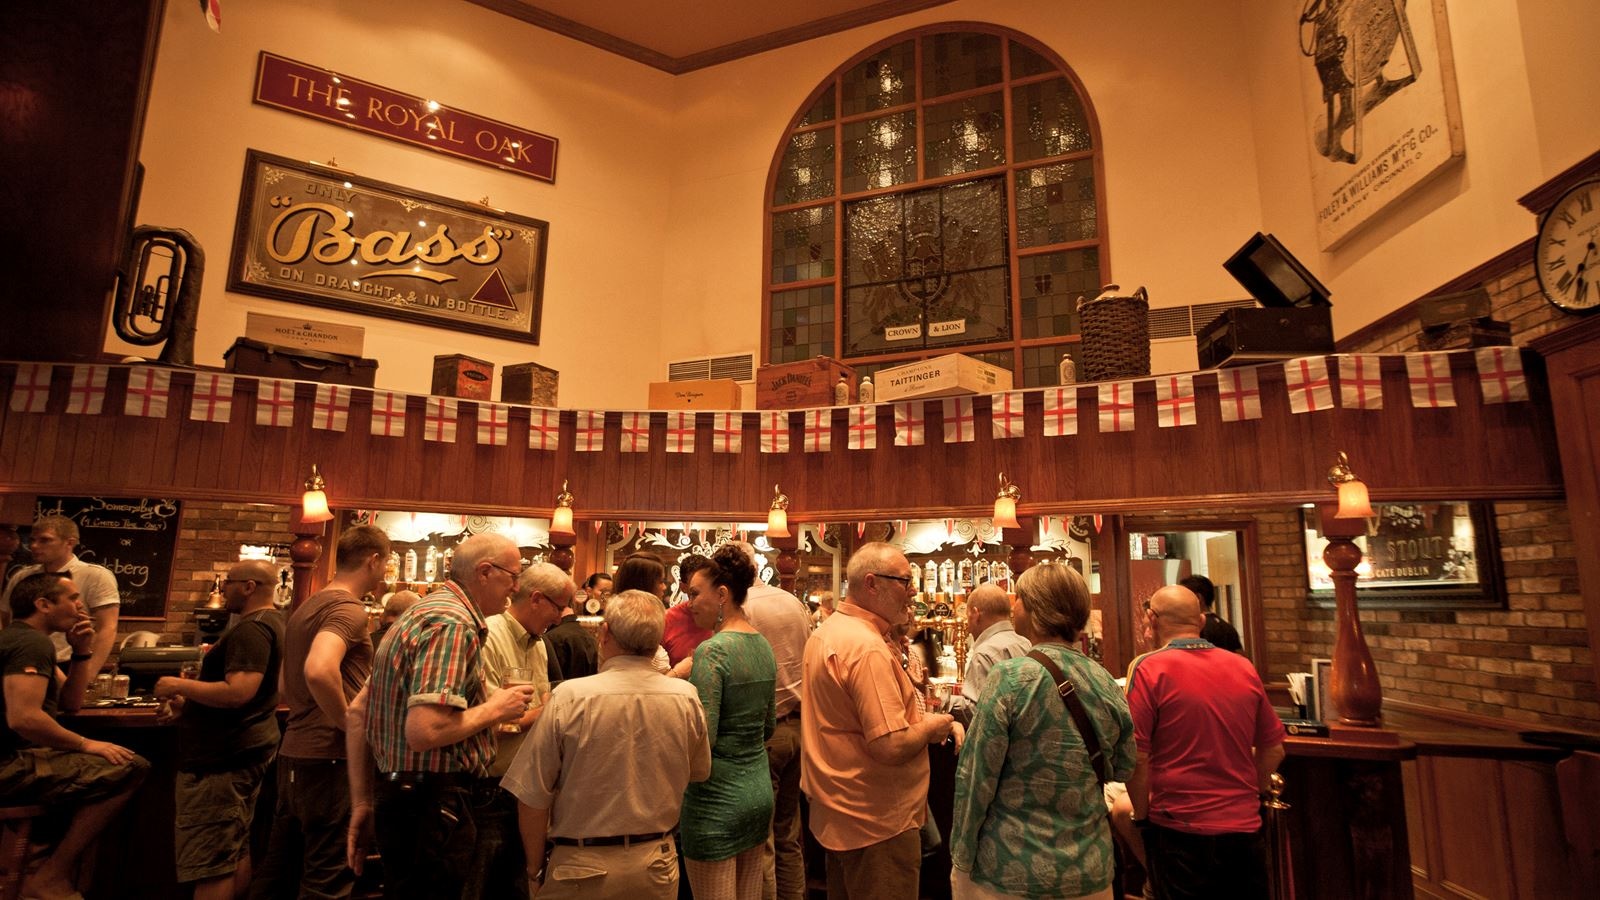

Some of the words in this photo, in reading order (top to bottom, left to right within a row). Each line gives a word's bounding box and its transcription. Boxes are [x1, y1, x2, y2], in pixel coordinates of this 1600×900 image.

[288, 73, 352, 112] THE
[367, 96, 464, 144] ROYAL
[475, 130, 534, 164] OAK
[1342, 192, 1348, 204] &
[1348, 159, 1389, 197] WILLIAMS
[304, 182, 357, 204] ONLY
[279, 266, 305, 282] ON
[314, 273, 395, 299] DRAUGHT
[406, 291, 417, 304] &
[424, 294, 440, 307] IN
[302, 331, 338, 341] CHANDON
[887, 327, 919, 337] CROWN
[941, 323, 961, 332] LION
[890, 369, 941, 387] TAITTINGER
[90, 496, 155, 519] Somersby
[1387, 536, 1443, 562] STOUT
[1397, 567, 1430, 577] DUBLIN
